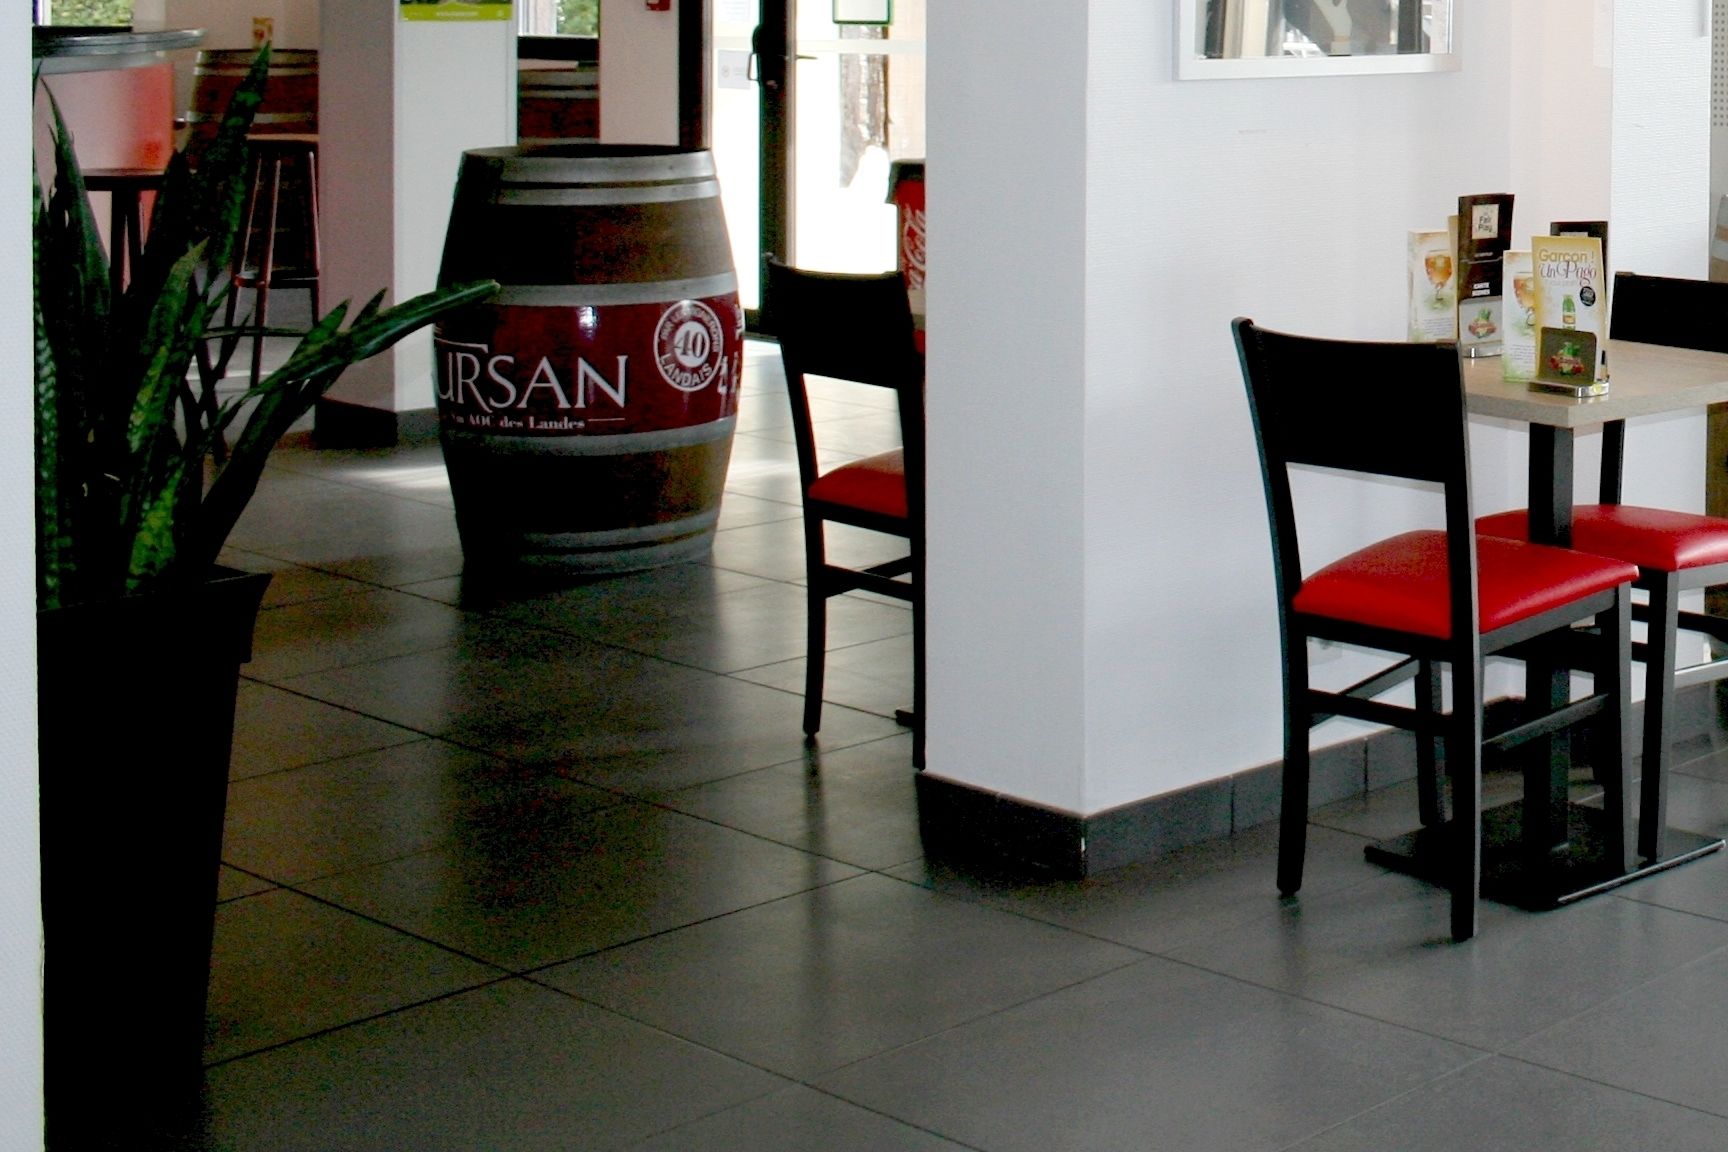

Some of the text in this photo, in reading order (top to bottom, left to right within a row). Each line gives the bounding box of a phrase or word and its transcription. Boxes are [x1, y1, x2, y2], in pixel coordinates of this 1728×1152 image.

[673, 330, 706, 359] 40
[660, 353, 713, 387] LANDAIS
[500, 416, 523, 428] des
[529, 416, 586, 429] Landes
